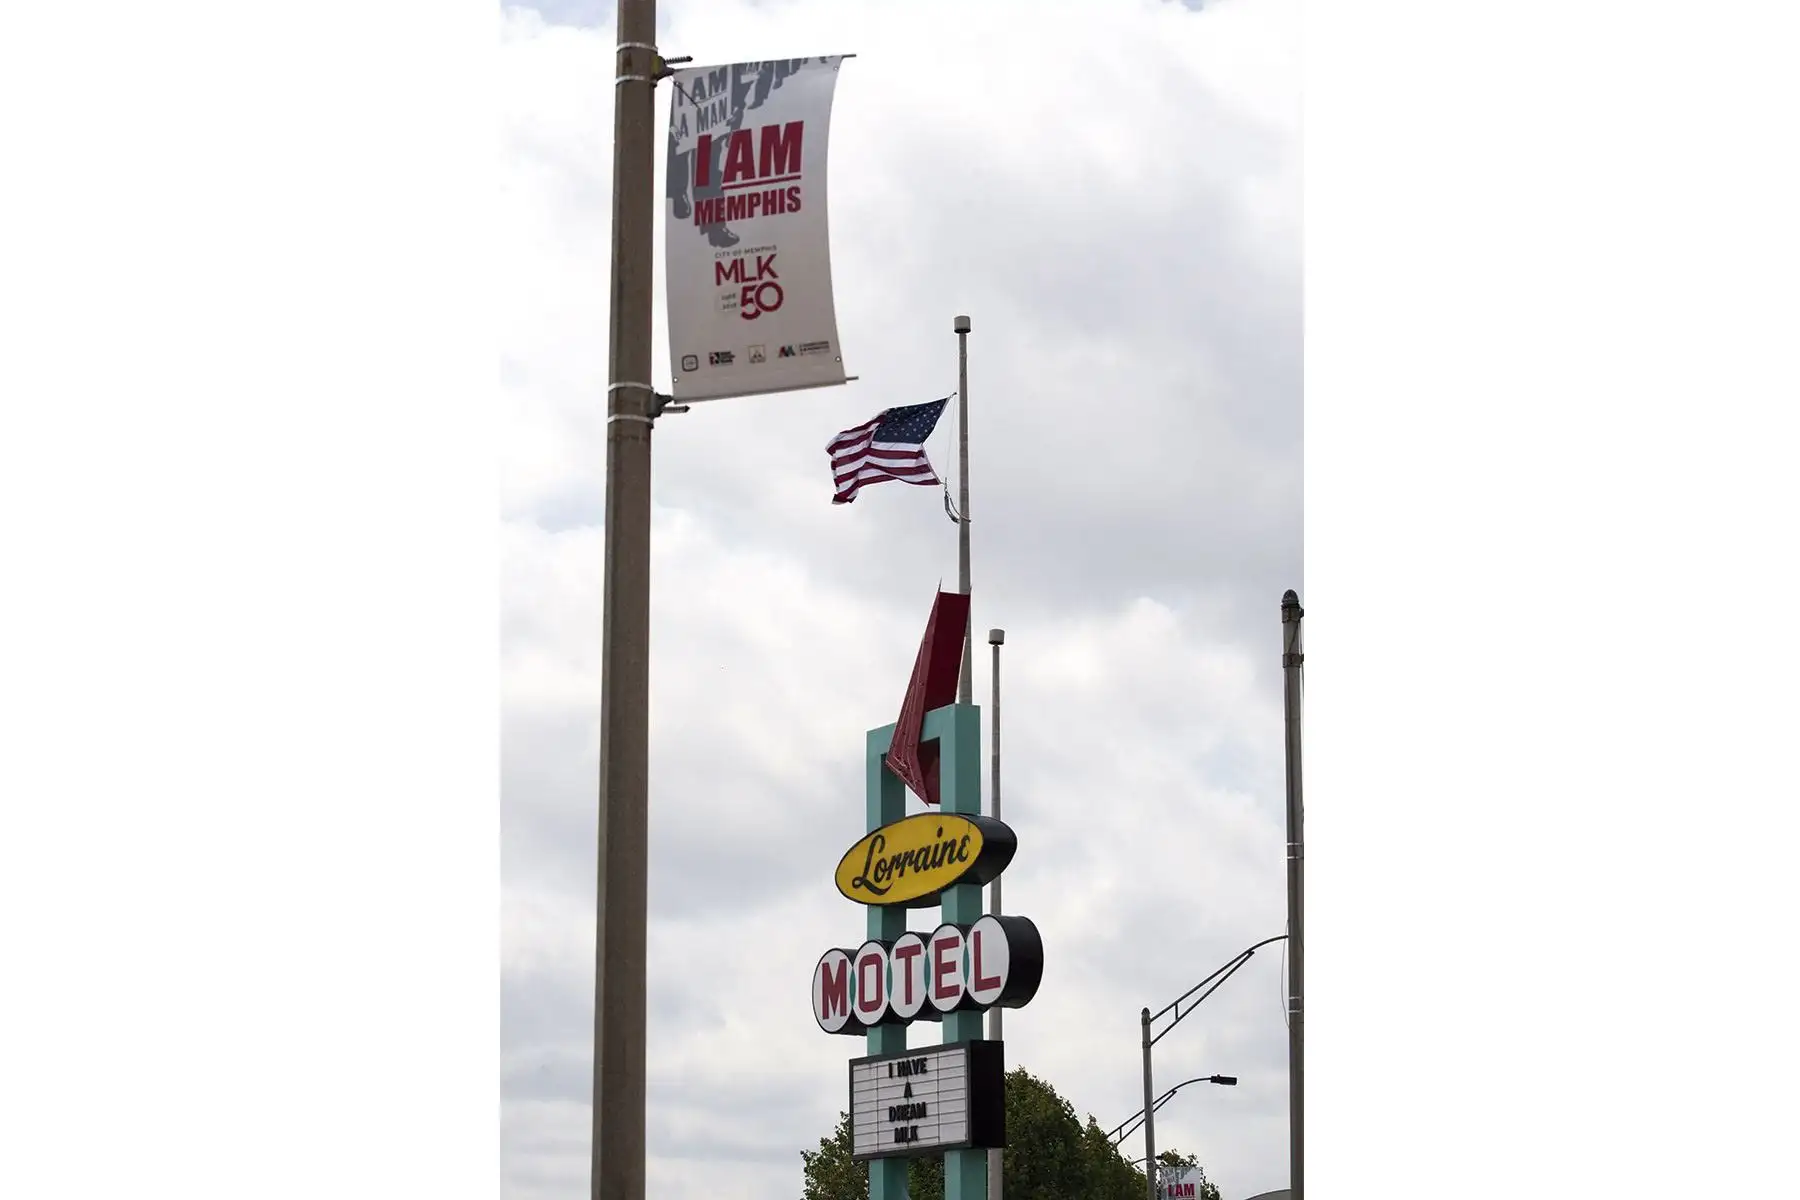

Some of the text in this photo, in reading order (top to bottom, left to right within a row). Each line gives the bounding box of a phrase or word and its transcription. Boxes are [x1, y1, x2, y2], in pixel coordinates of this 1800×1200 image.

[691, 66, 728, 101] AM
[680, 97, 728, 138] A MAN
[695, 120, 804, 187] I AM
[694, 186, 802, 226] MEMPHIS
[715, 254, 779, 286] MLK
[740, 281, 784, 320] 50
[852, 825, 971, 896] Lorraine
[821, 930, 1001, 1020] MOTEL
[888, 1057, 928, 1079] I HAVE
[903, 1082, 913, 1098] A
[889, 1102, 927, 1122] DREAM
[894, 1125, 918, 1143] MLK
[1168, 1183, 1194, 1196] I AM
